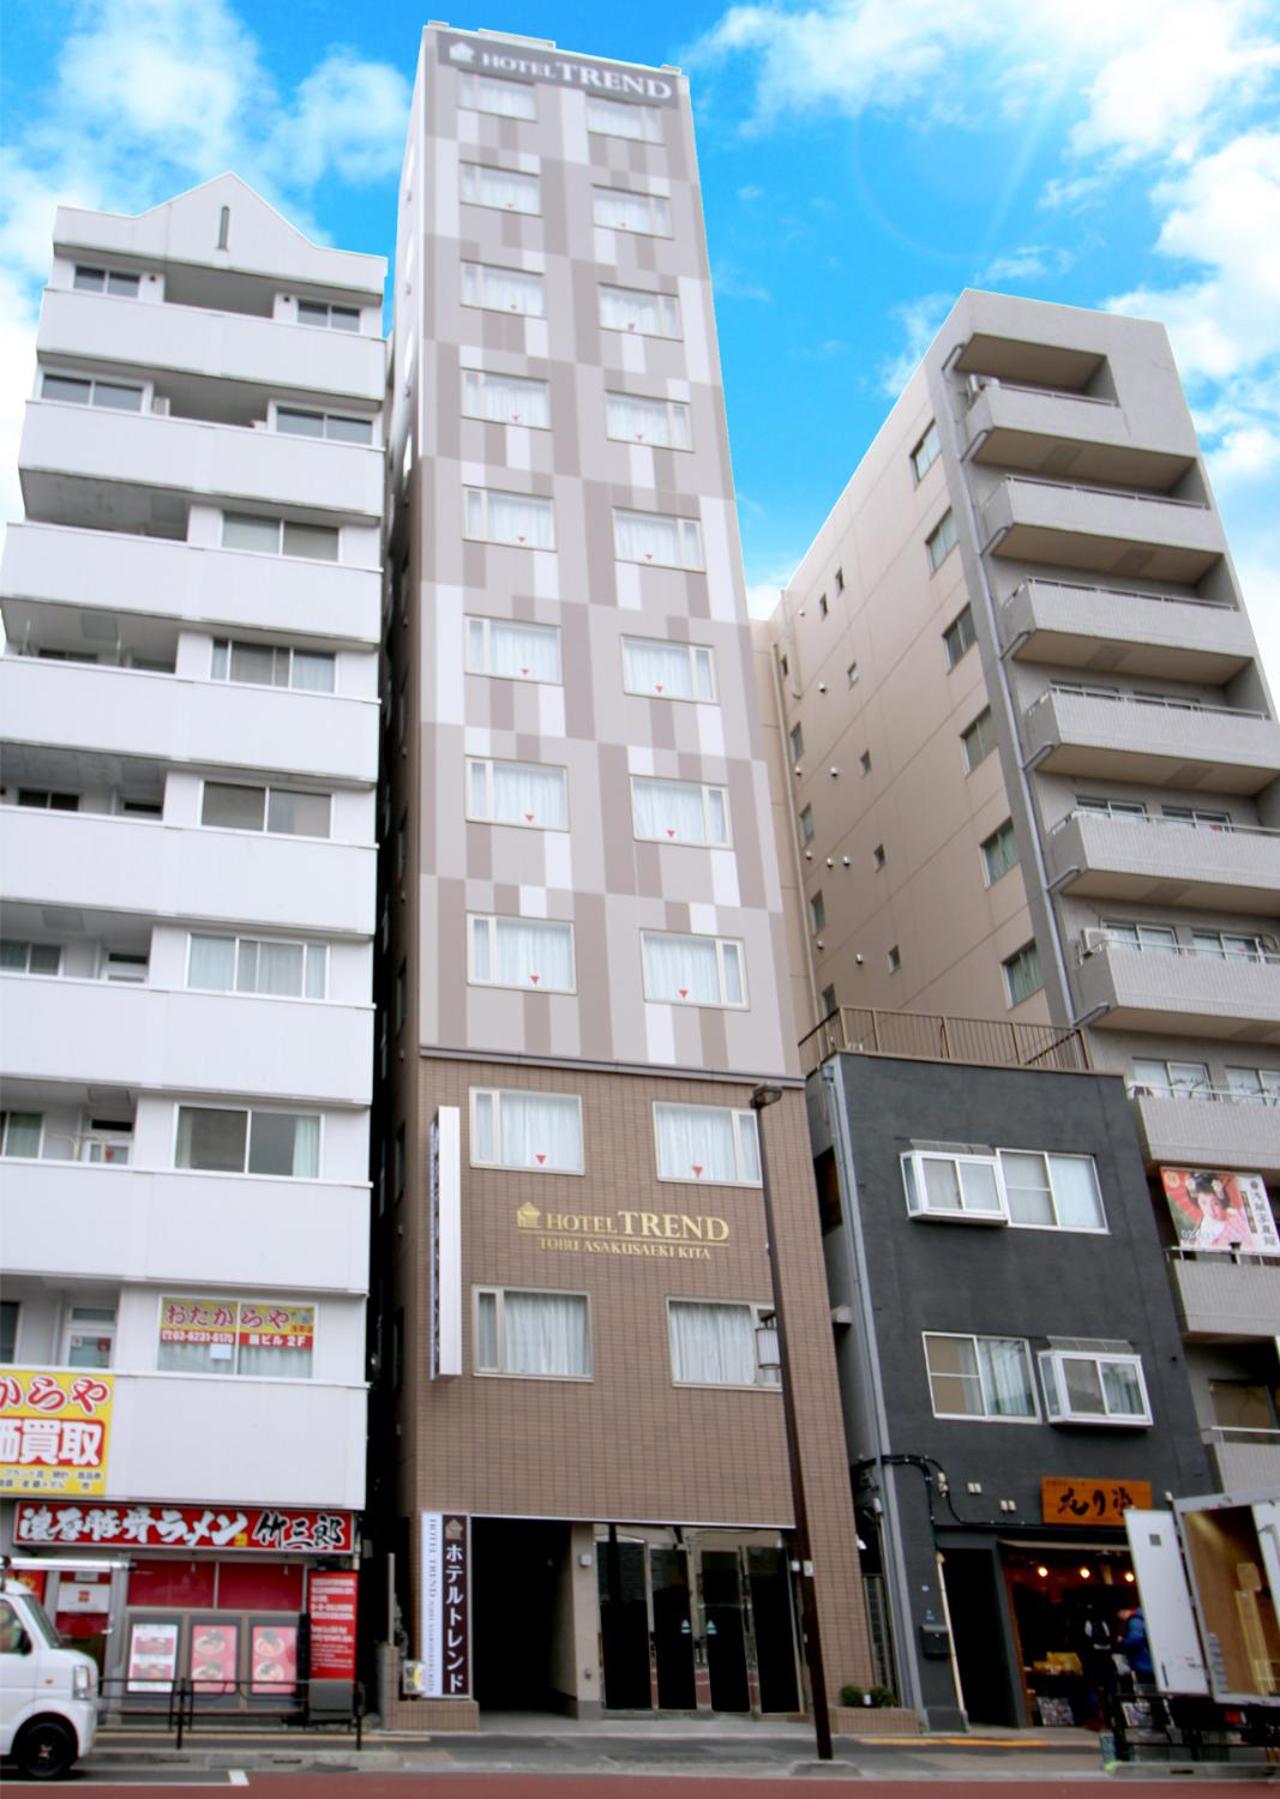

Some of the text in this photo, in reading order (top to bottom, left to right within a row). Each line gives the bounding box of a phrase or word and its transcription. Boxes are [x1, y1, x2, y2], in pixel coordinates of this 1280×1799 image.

[482, 52, 672, 99] HOTEL TREND
[546, 1210, 730, 1241] HOTEL TREND
[677, 1246, 711, 1260] KITA
[166, 1304, 290, 1329] おたからや
[252, 1509, 345, 1550] 竹三郎
[445, 1543, 465, 1694] ホテルトレンド
